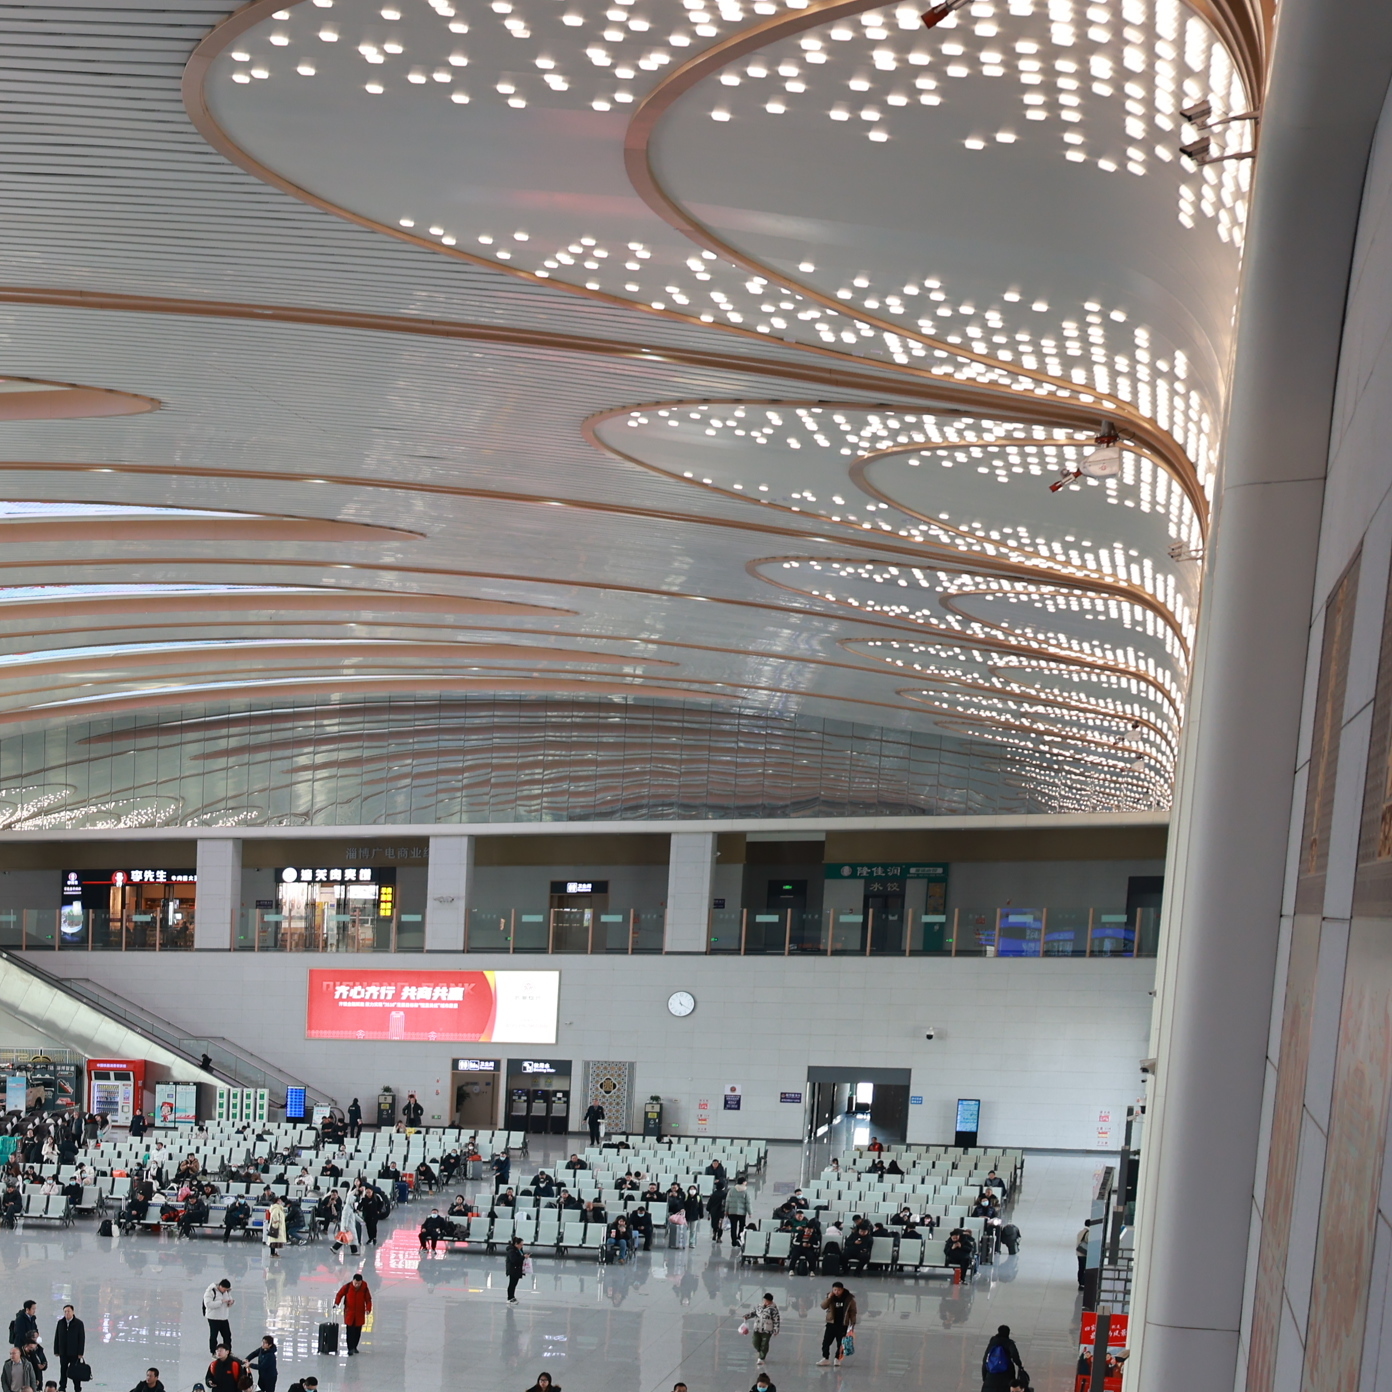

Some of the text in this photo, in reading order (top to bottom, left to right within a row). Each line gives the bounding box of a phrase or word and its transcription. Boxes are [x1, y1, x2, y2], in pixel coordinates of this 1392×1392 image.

[869, 882, 900, 892] 水饺
[334, 985, 396, 1000] 齐心齐行
